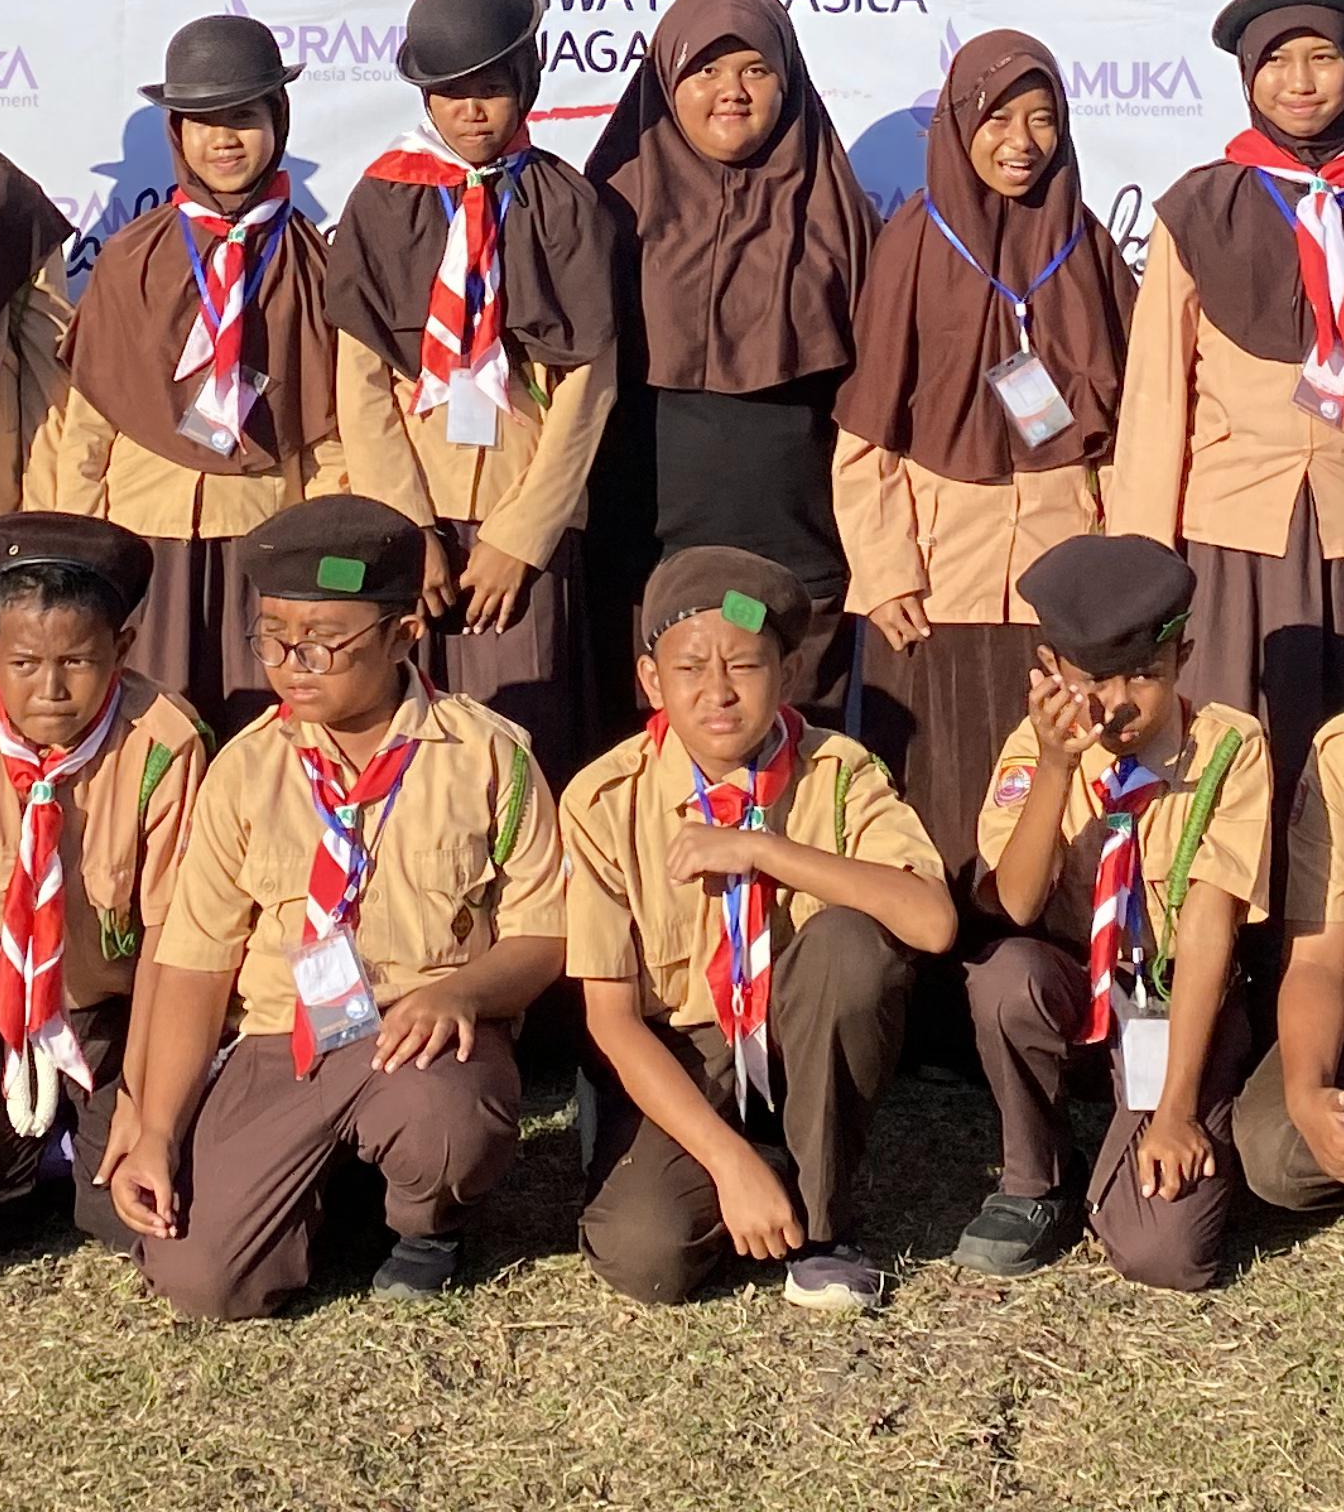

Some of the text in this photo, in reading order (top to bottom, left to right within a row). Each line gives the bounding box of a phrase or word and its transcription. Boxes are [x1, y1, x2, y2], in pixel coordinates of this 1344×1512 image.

[304, 66, 346, 81] nesia
[1058, 56, 1203, 99] MUKA
[1069, 102, 1203, 117] cout Movement
